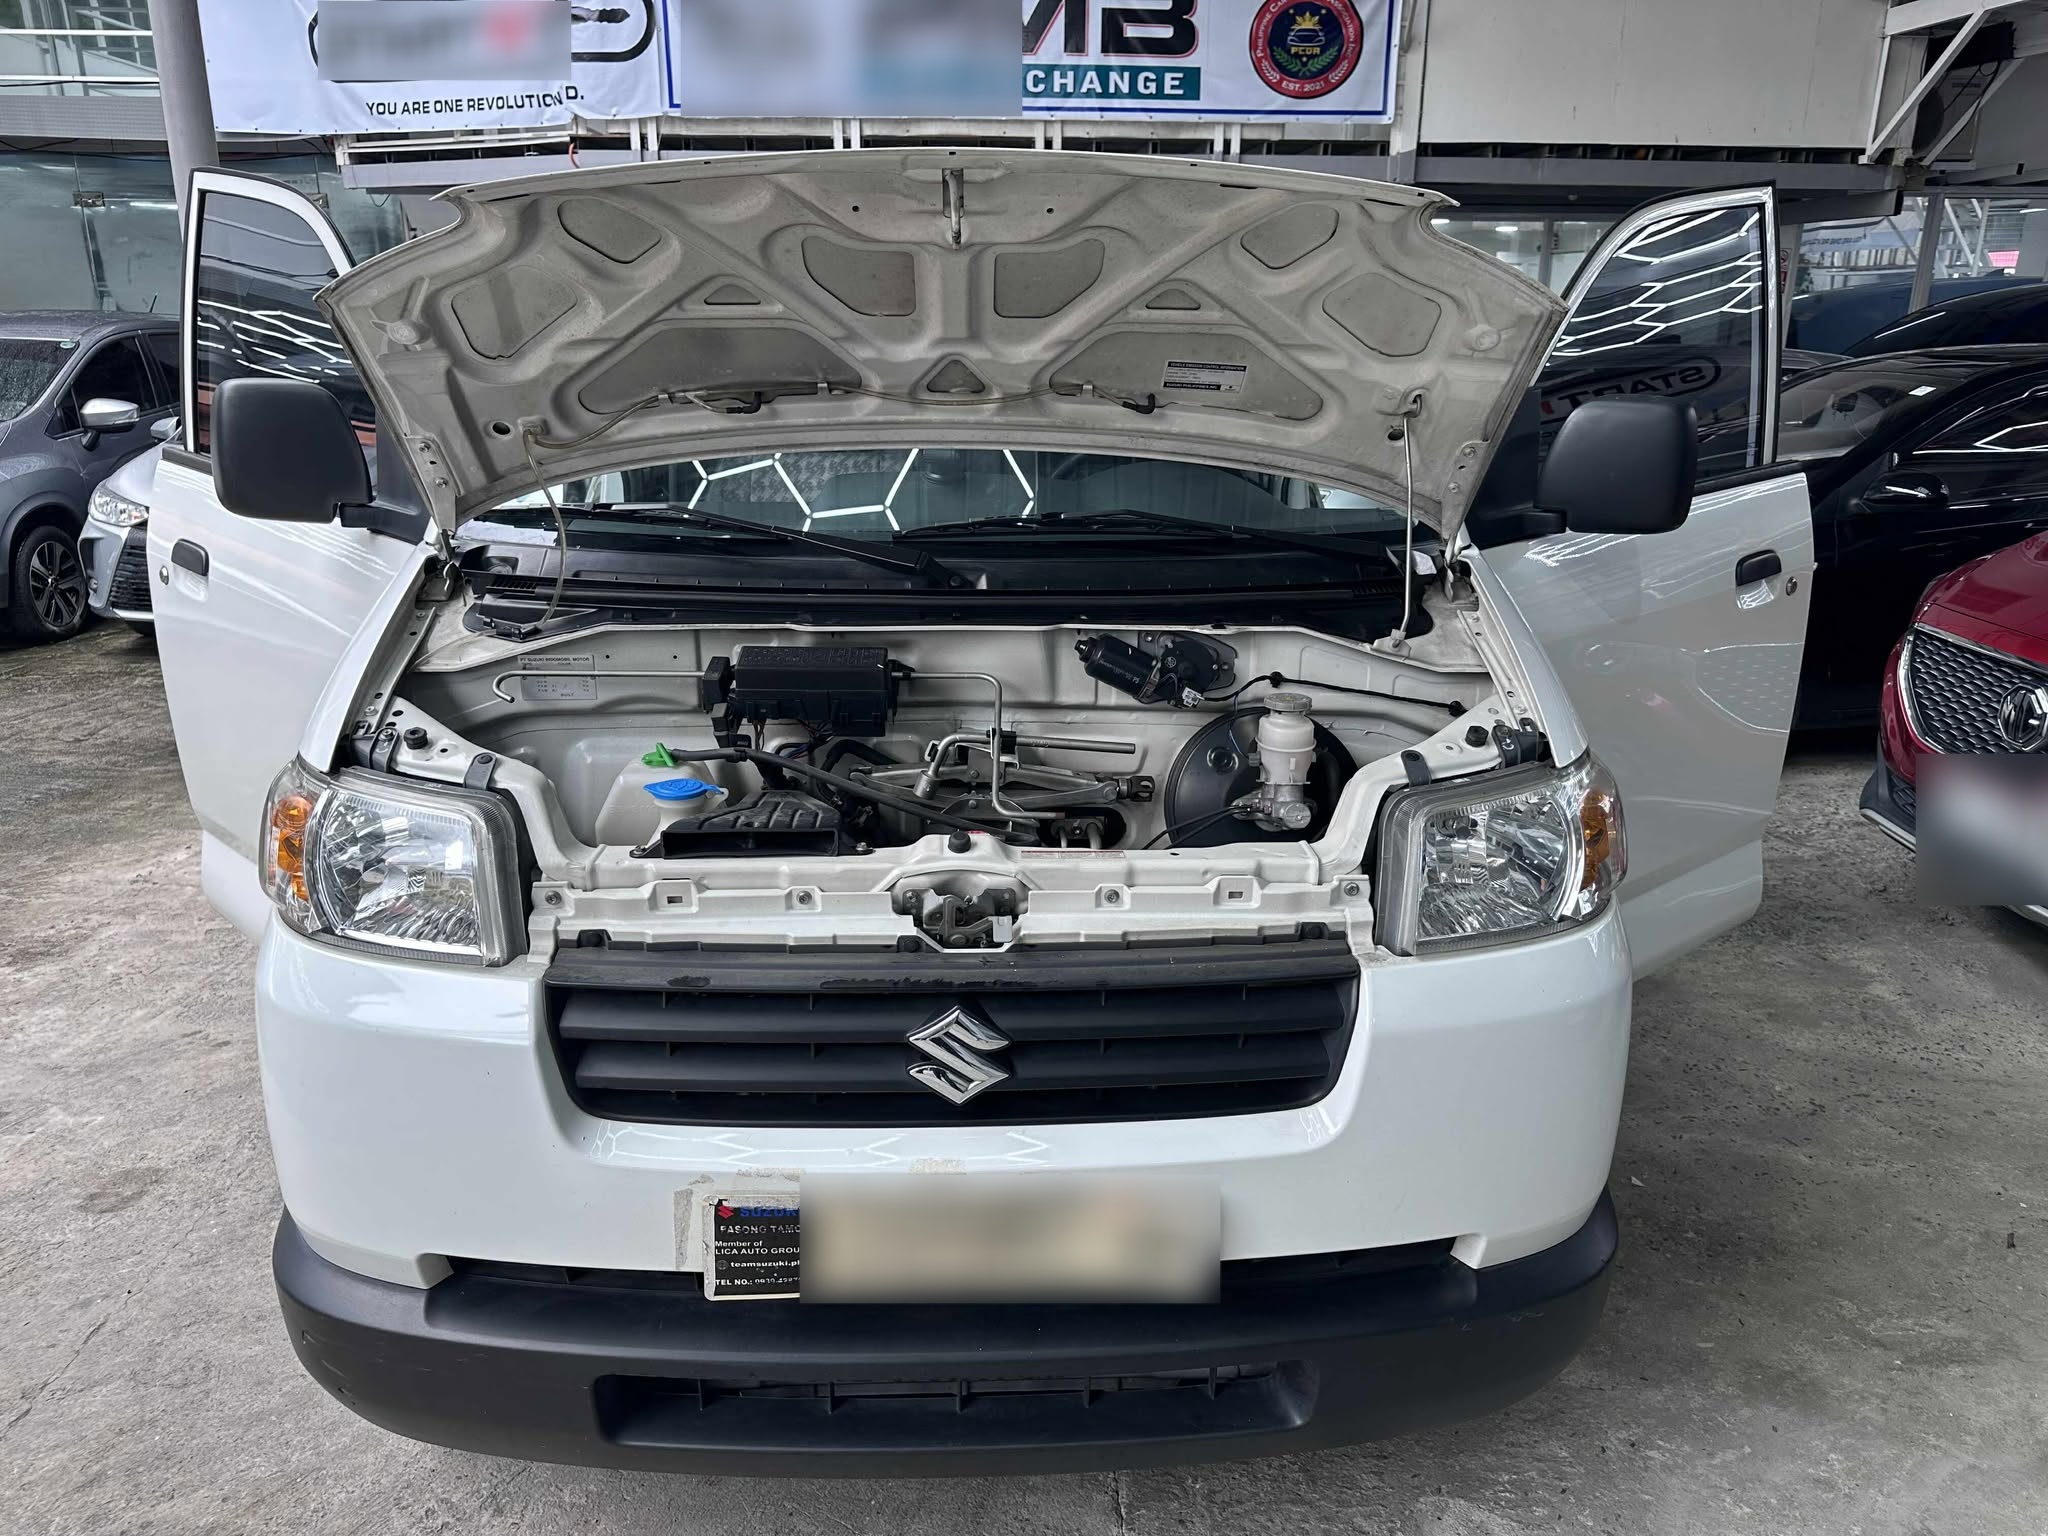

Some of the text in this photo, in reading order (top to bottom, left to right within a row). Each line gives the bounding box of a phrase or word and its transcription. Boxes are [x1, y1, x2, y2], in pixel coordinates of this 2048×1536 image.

[1026, 70, 1184, 95] CHANGE
[1281, 80, 1325, 92] EST. 2021
[366, 102, 397, 116] YOU
[401, 101, 430, 115] ARE
[434, 99, 463, 113] ONE
